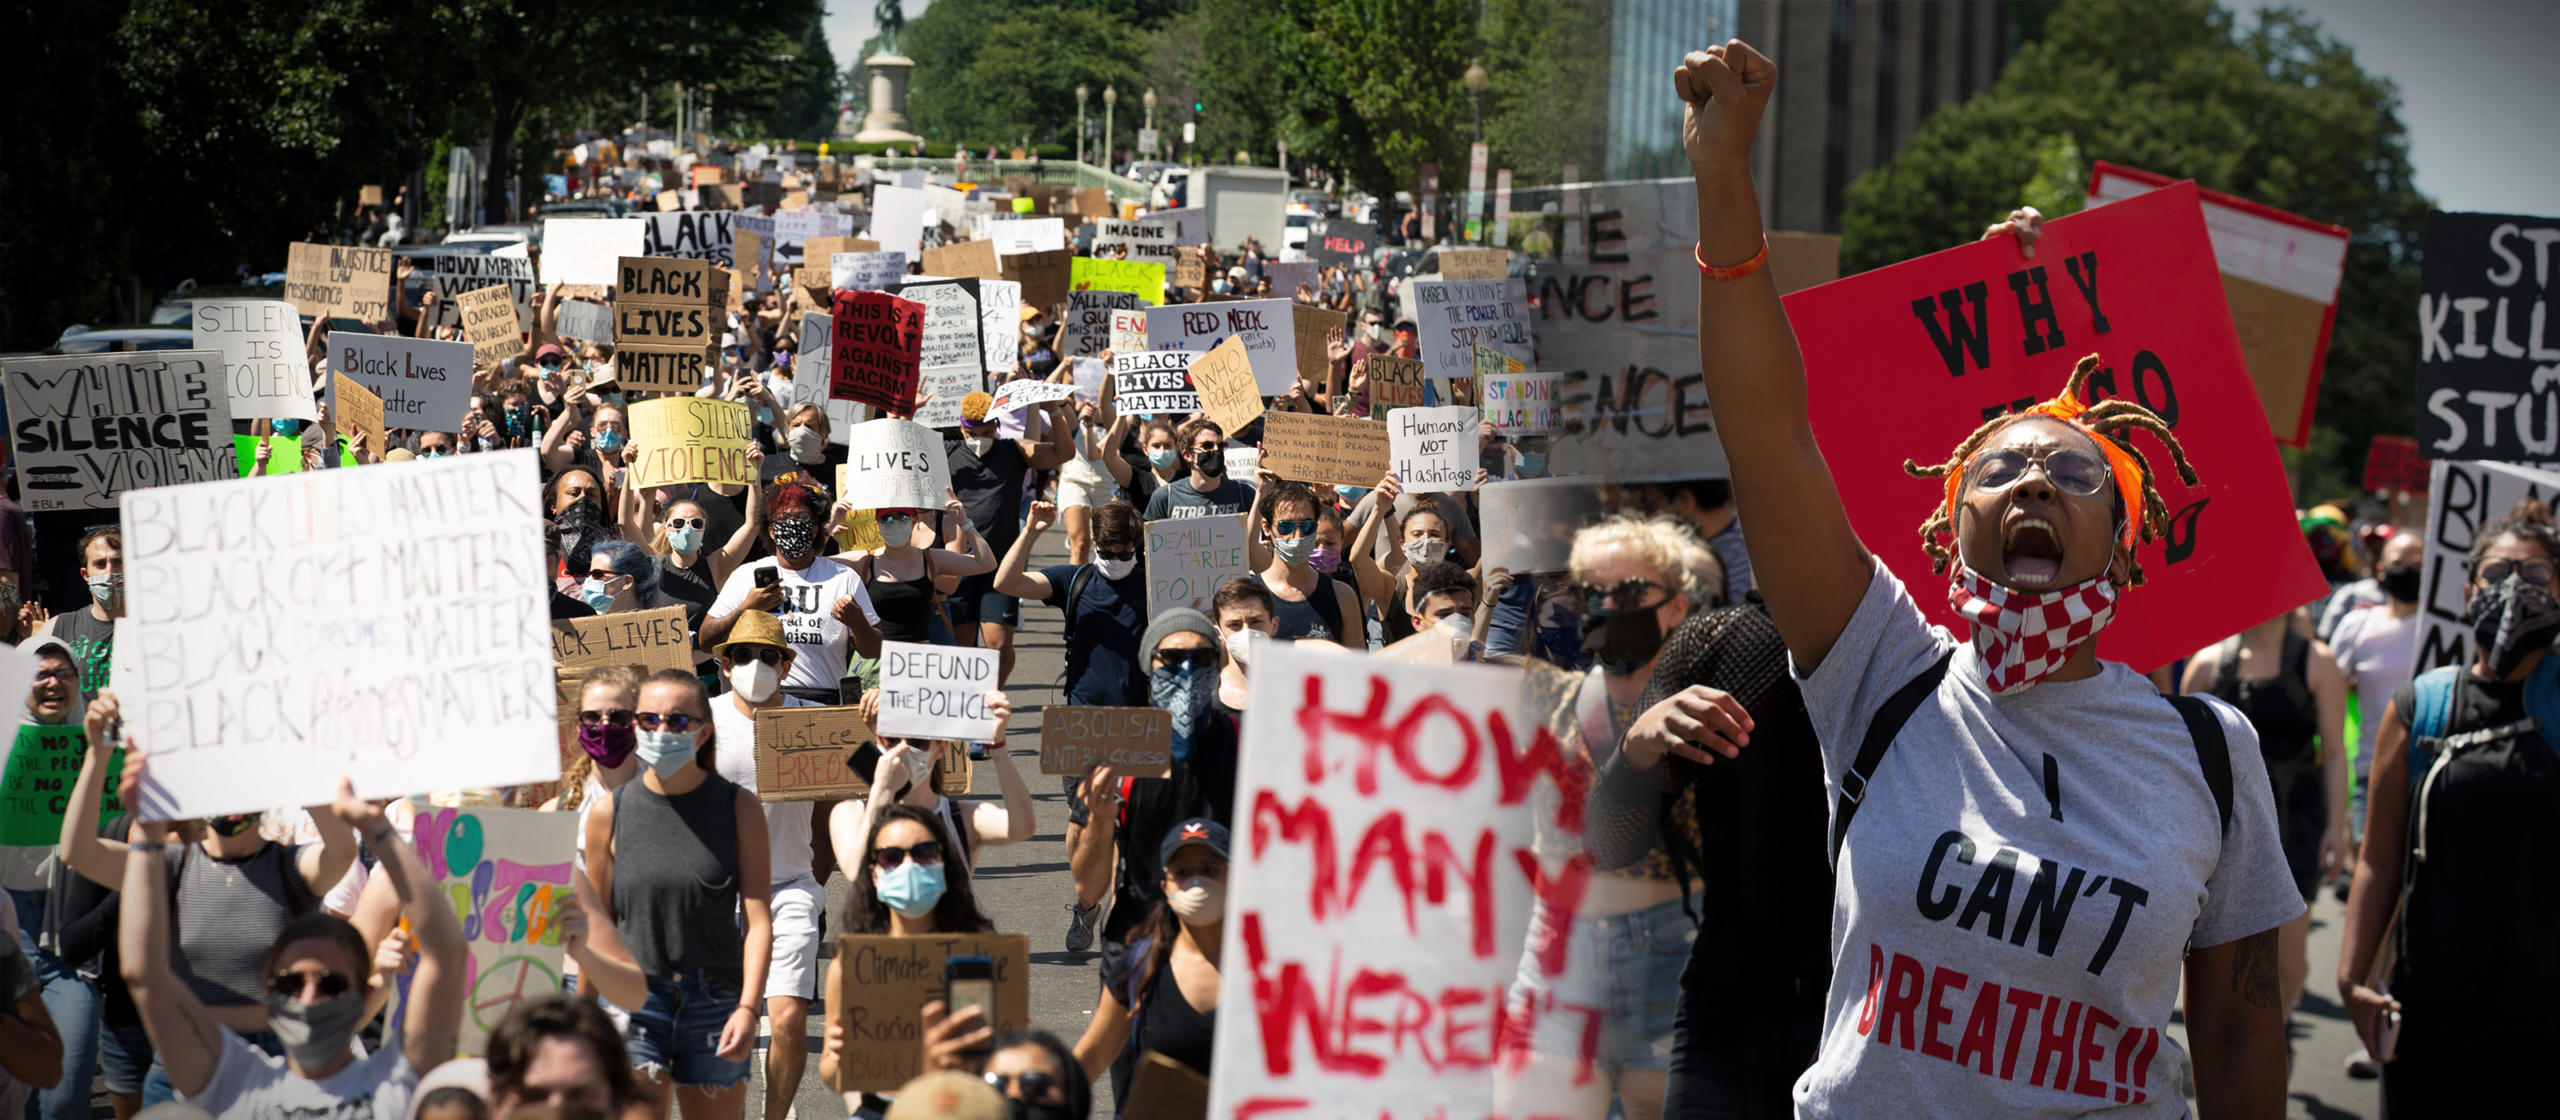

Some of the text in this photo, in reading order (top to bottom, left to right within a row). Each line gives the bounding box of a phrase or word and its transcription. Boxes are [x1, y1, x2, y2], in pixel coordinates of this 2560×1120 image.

[1105, 224, 1165, 239] IMAGINE
[1136, 244, 1174, 256] TIRED
[1324, 236, 1365, 254] HELP
[2487, 223, 2560, 291] ST
[330, 248, 388, 274] INJUSTICE
[436, 255, 479, 275] HOW
[485, 257, 527, 278] MANY
[1083, 261, 1153, 281] BLACK
[331, 271, 352, 283] LAW
[623, 266, 702, 299] BLACK
[287, 281, 343, 306] resistance
[459, 292, 491, 310] IF YOU
[980, 283, 1018, 308] OLKS
[1102, 293, 1137, 311] JUST
[1420, 286, 1451, 304] KAREN
[1479, 283, 1504, 300] HAVE
[199, 306, 303, 337] SILENC
[353, 301, 386, 317] DUTY
[467, 303, 510, 326] OUTRAGED
[840, 300, 918, 329] THIS IS A
[1466, 304, 1499, 322] POWER
[1501, 302, 1515, 319] TO
[1911, 251, 2112, 378] WHY
[620, 310, 704, 338] LIVES
[1066, 323, 1090, 336] THIS
[1116, 316, 1147, 333] EN
[1183, 308, 1268, 336] RED NECK
[470, 327, 488, 343] YOU
[839, 321, 917, 353] REVOLT
[1080, 336, 1109, 354] SHI
[1451, 326, 1478, 348] STOP
[247, 341, 282, 359] IS
[839, 346, 914, 379] AGAINST
[344, 347, 447, 381] Black Lives
[616, 351, 703, 387] MATTER
[1117, 353, 1190, 374] BLACK
[1195, 349, 1242, 392] WHO
[1370, 359, 1424, 388] BLACK
[9, 360, 216, 418] WHITE
[843, 365, 906, 397] RACISM
[1118, 371, 1185, 393] LIVES
[1207, 369, 1254, 411] POLICES
[1488, 380, 1559, 400] STANDING
[1119, 394, 1203, 412] MATTER
[1225, 391, 1248, 414] THE
[1379, 382, 1424, 407] LIVES
[688, 401, 752, 440] SILENCE
[1218, 394, 1262, 434] POLICE?
[1267, 412, 1305, 424] BREONNA
[1340, 421, 1370, 431] SANDRA
[1402, 414, 1464, 438] Humans
[1488, 408, 1533, 428] BLACK
[16, 413, 210, 452] SILENCE
[1265, 427, 1300, 436] MICHAEL
[1321, 440, 1339, 450] ERIC
[1345, 442, 1381, 452] REASON
[1420, 440, 1449, 455] NOT
[633, 446, 757, 485] VIOLENCE
[860, 452, 930, 473] LIVES
[1399, 459, 1473, 488] Hashtags
[32, 499, 65, 509] #BLM
[127, 460, 534, 559] BLACK LIVES MATTER
[1171, 503, 1241, 519] STAR TREK
[1150, 528, 1225, 553] DEMILI-
[1174, 547, 1242, 570] TARIZE
[135, 555, 285, 625] BLACK
[382, 524, 540, 602] MATTERS
[605, 617, 684, 652] LIVES
[808, 618, 822, 628] of
[140, 612, 289, 692] BLACK
[404, 594, 547, 664] MATTER
[889, 652, 990, 681] DEFUND
[144, 674, 304, 756] BLACK
[420, 658, 558, 736] MATTER
[887, 687, 996, 720] THE POLICE
[767, 715, 857, 750] Justice
[1052, 710, 1161, 741] ABOLISH
[19, 734, 32, 748] IS
[41, 736, 69, 750] NO
[1295, 673, 1597, 835] HOW
[17, 756, 42, 770] THE
[1041, 746, 1168, 768] ANTI-BLACKNESS
[34, 778, 62, 792] NO
[2043, 752, 2064, 823] I
[1250, 788, 1597, 978] MANY
[1916, 830, 2149, 976] CAN'T
[855, 945, 930, 985] Climate
[1240, 912, 1610, 1088] WEREN'T
[848, 1006, 922, 1041] Racial
[1857, 943, 2159, 1105] BREATHE!!
